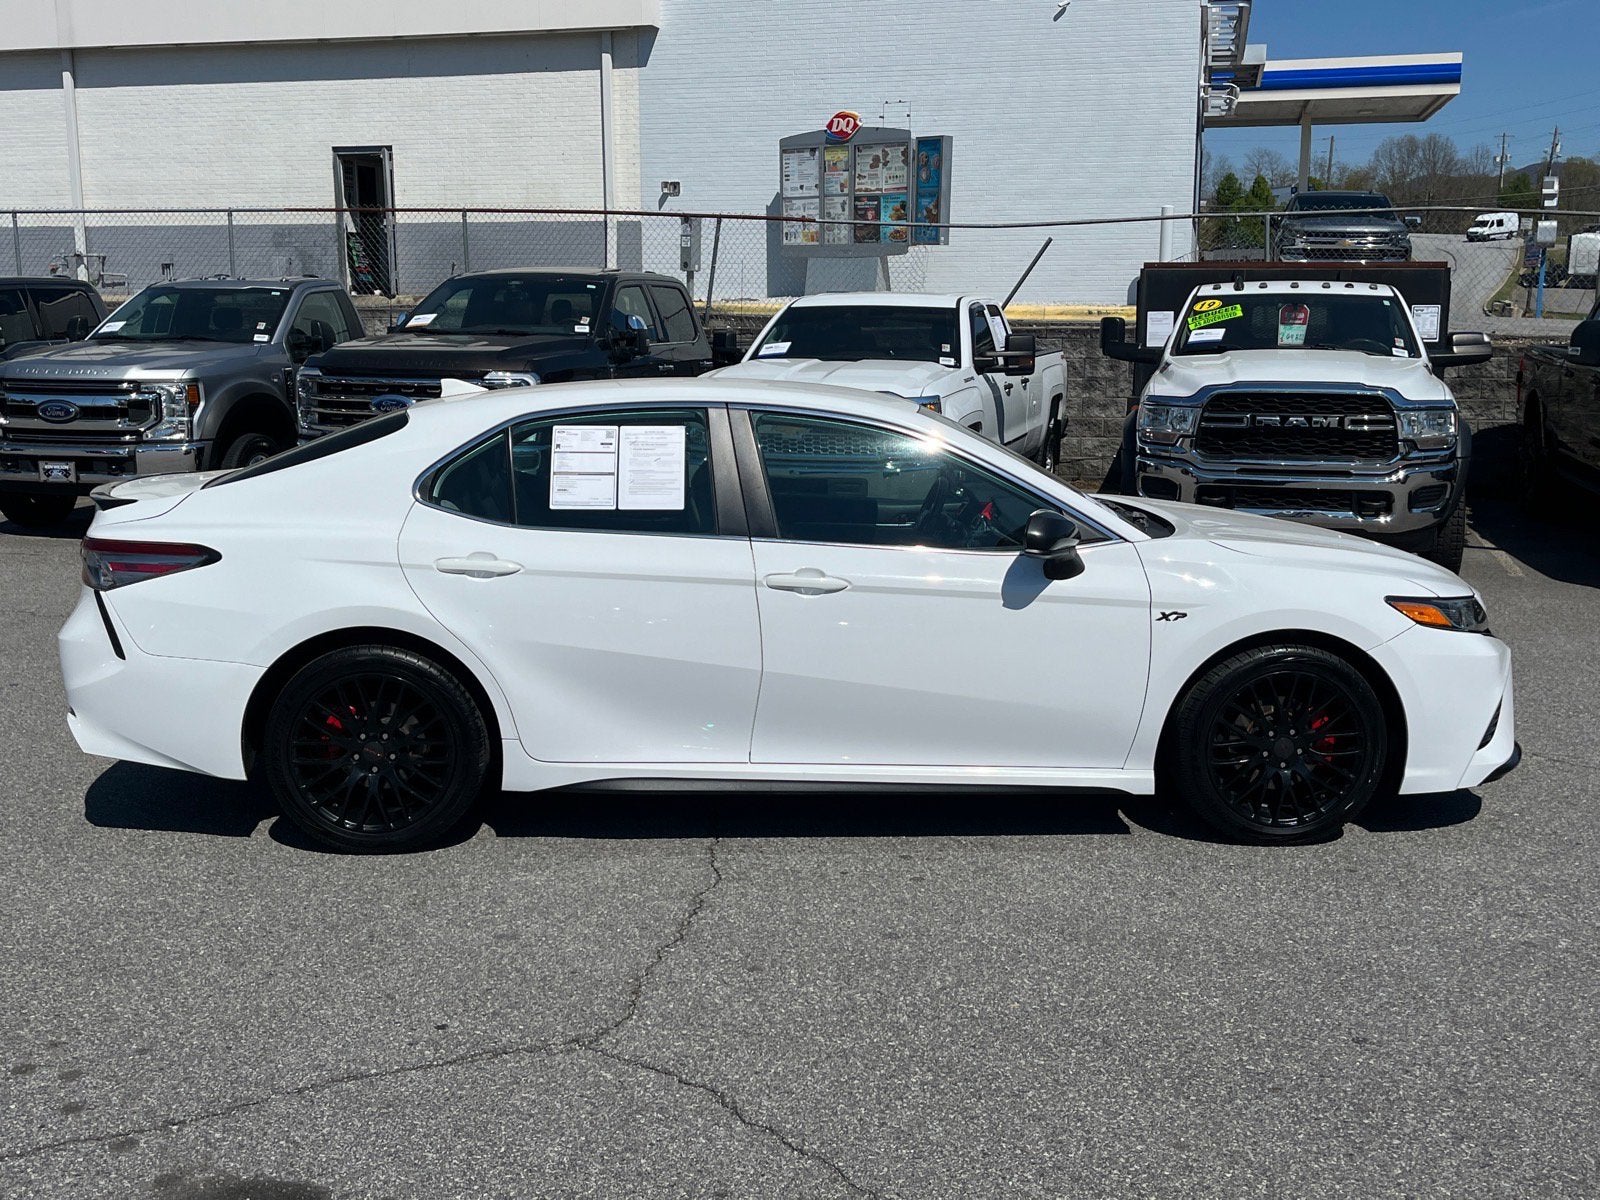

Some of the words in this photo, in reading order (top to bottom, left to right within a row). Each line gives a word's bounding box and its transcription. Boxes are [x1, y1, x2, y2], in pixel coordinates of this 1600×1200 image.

[831, 117, 855, 133] DQ
[1199, 301, 1217, 310] 19
[46, 406, 65, 416] Ford
[1256, 416, 1340, 428] RAM
[1155, 611, 1188, 622] XP
